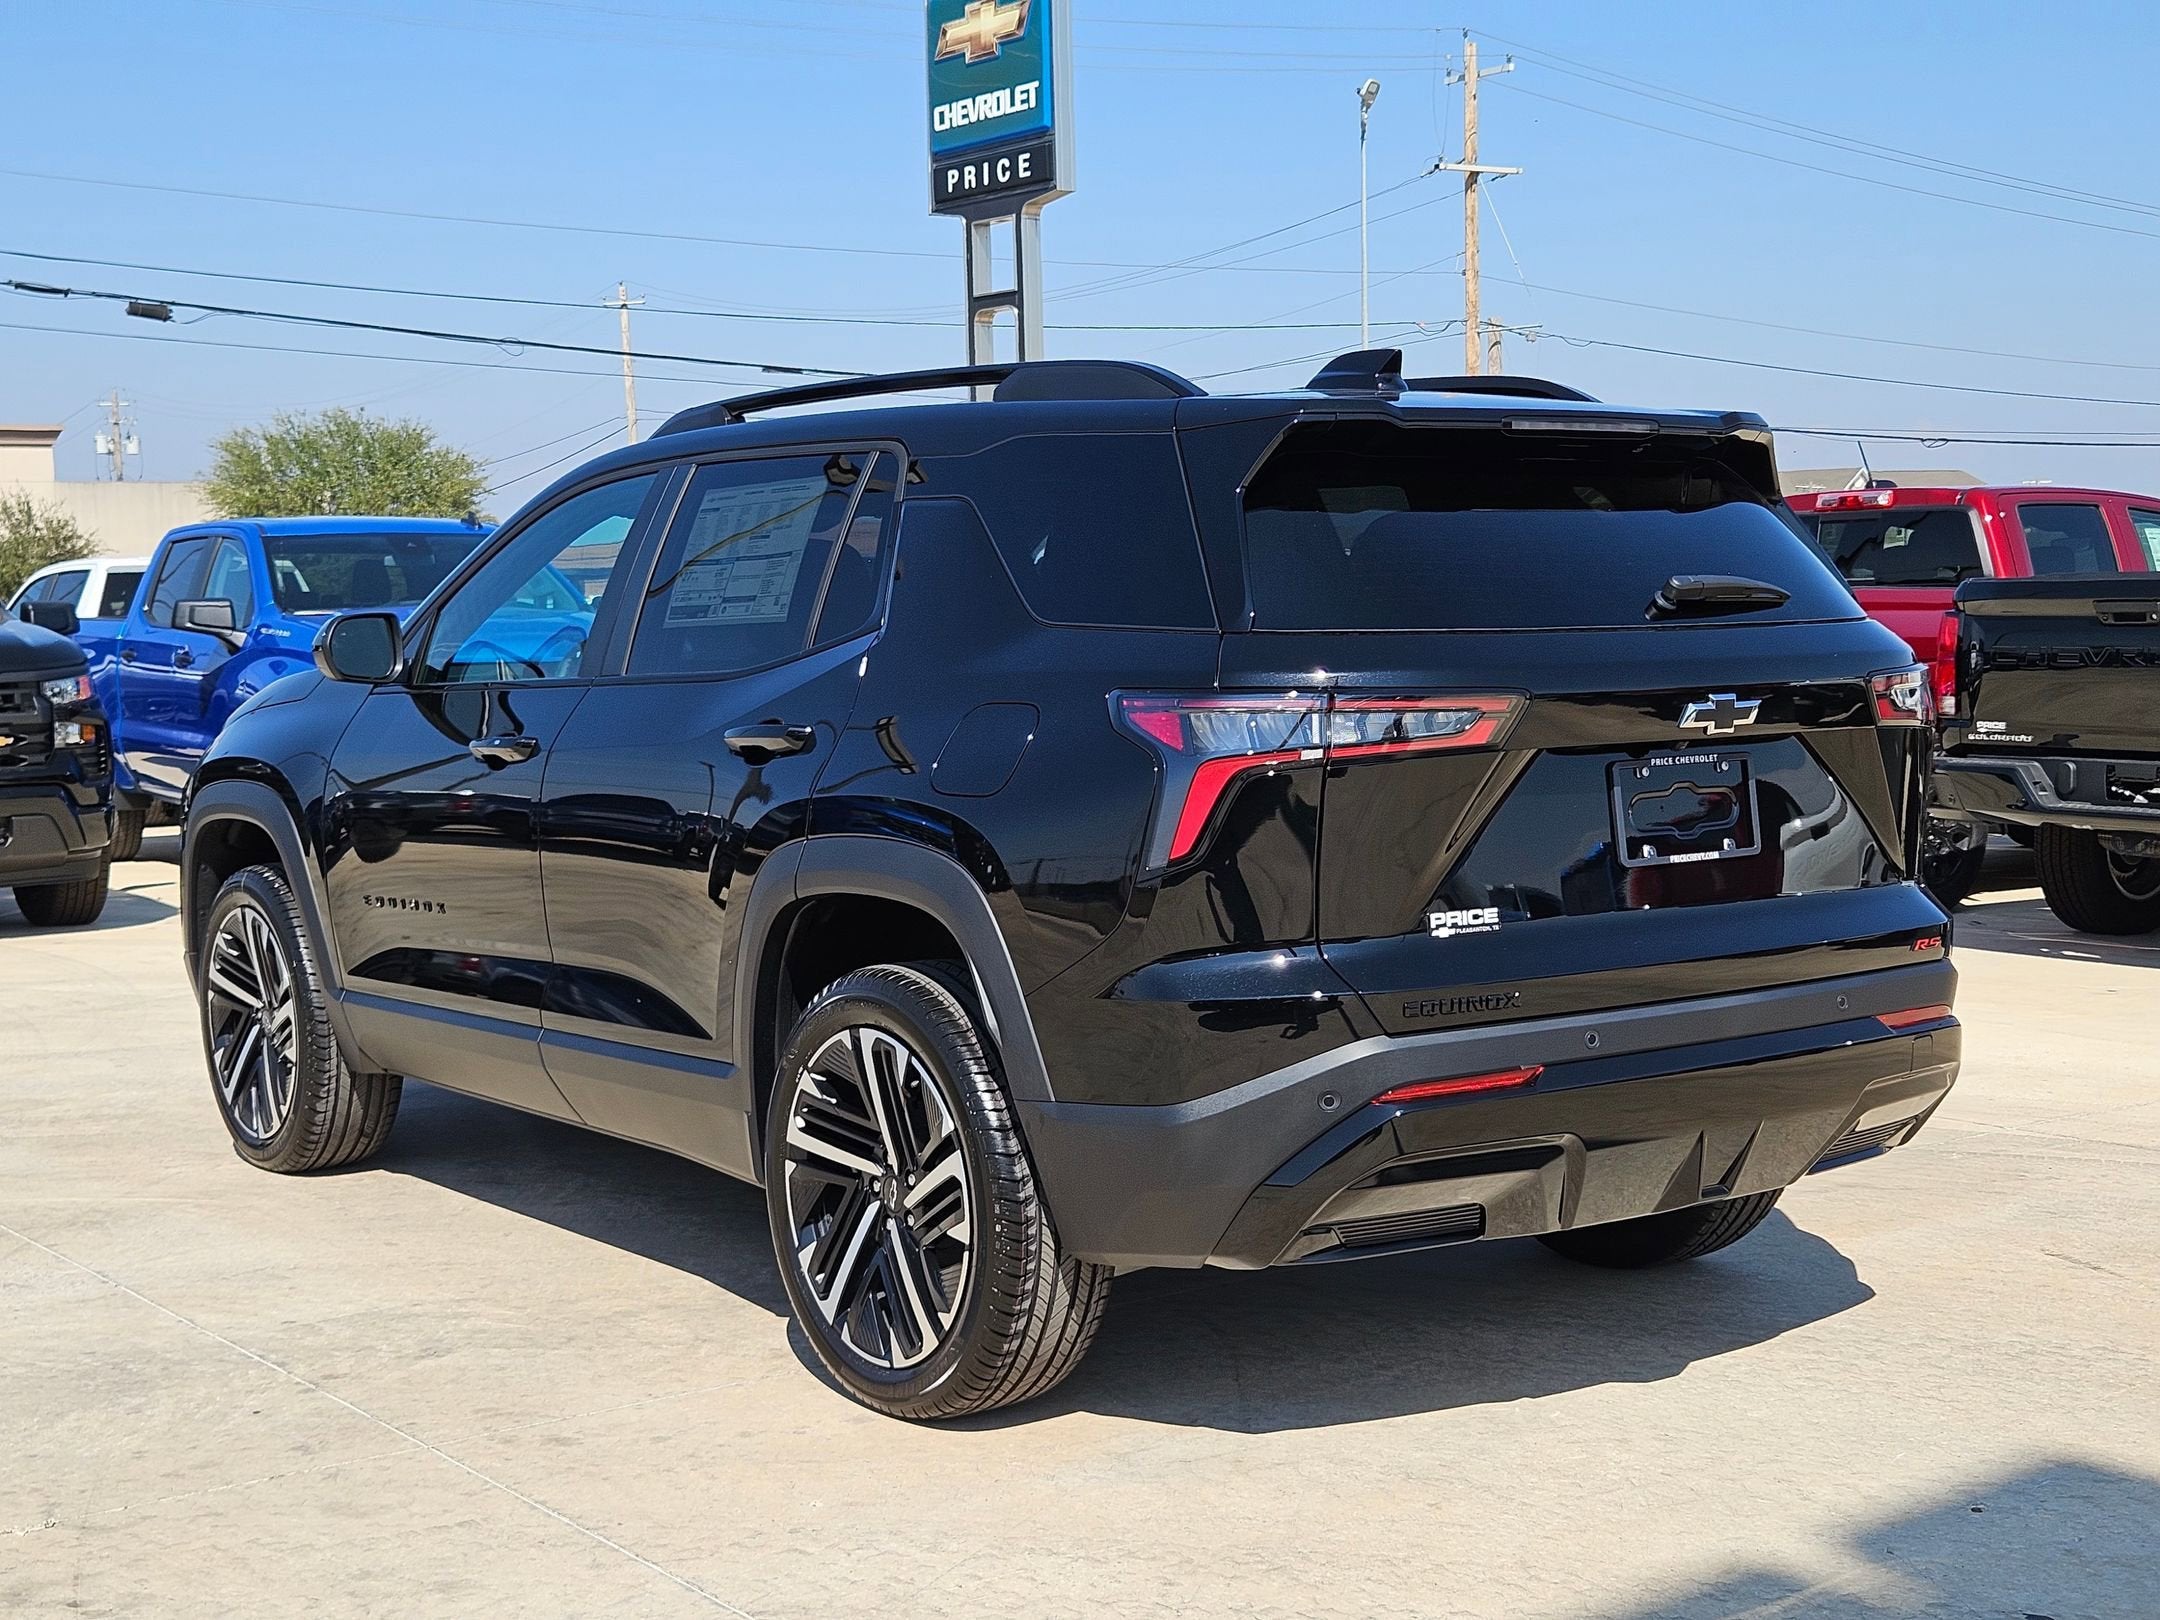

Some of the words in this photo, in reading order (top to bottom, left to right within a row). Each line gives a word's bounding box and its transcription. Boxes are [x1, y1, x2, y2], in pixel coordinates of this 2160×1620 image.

[933, 80, 1039, 132] CHEVROLET
[947, 152, 1032, 193] PRICE
[1968, 733, 2033, 743] COLORADO
[1650, 757, 1674, 766] PRICE
[1675, 754, 1719, 765] CHEVROLET
[363, 894, 446, 914] EQUINOX
[1430, 907, 1499, 928] PRICE
[1912, 936, 1941, 951] RS
[1403, 992, 1520, 1018] EQUINOX
